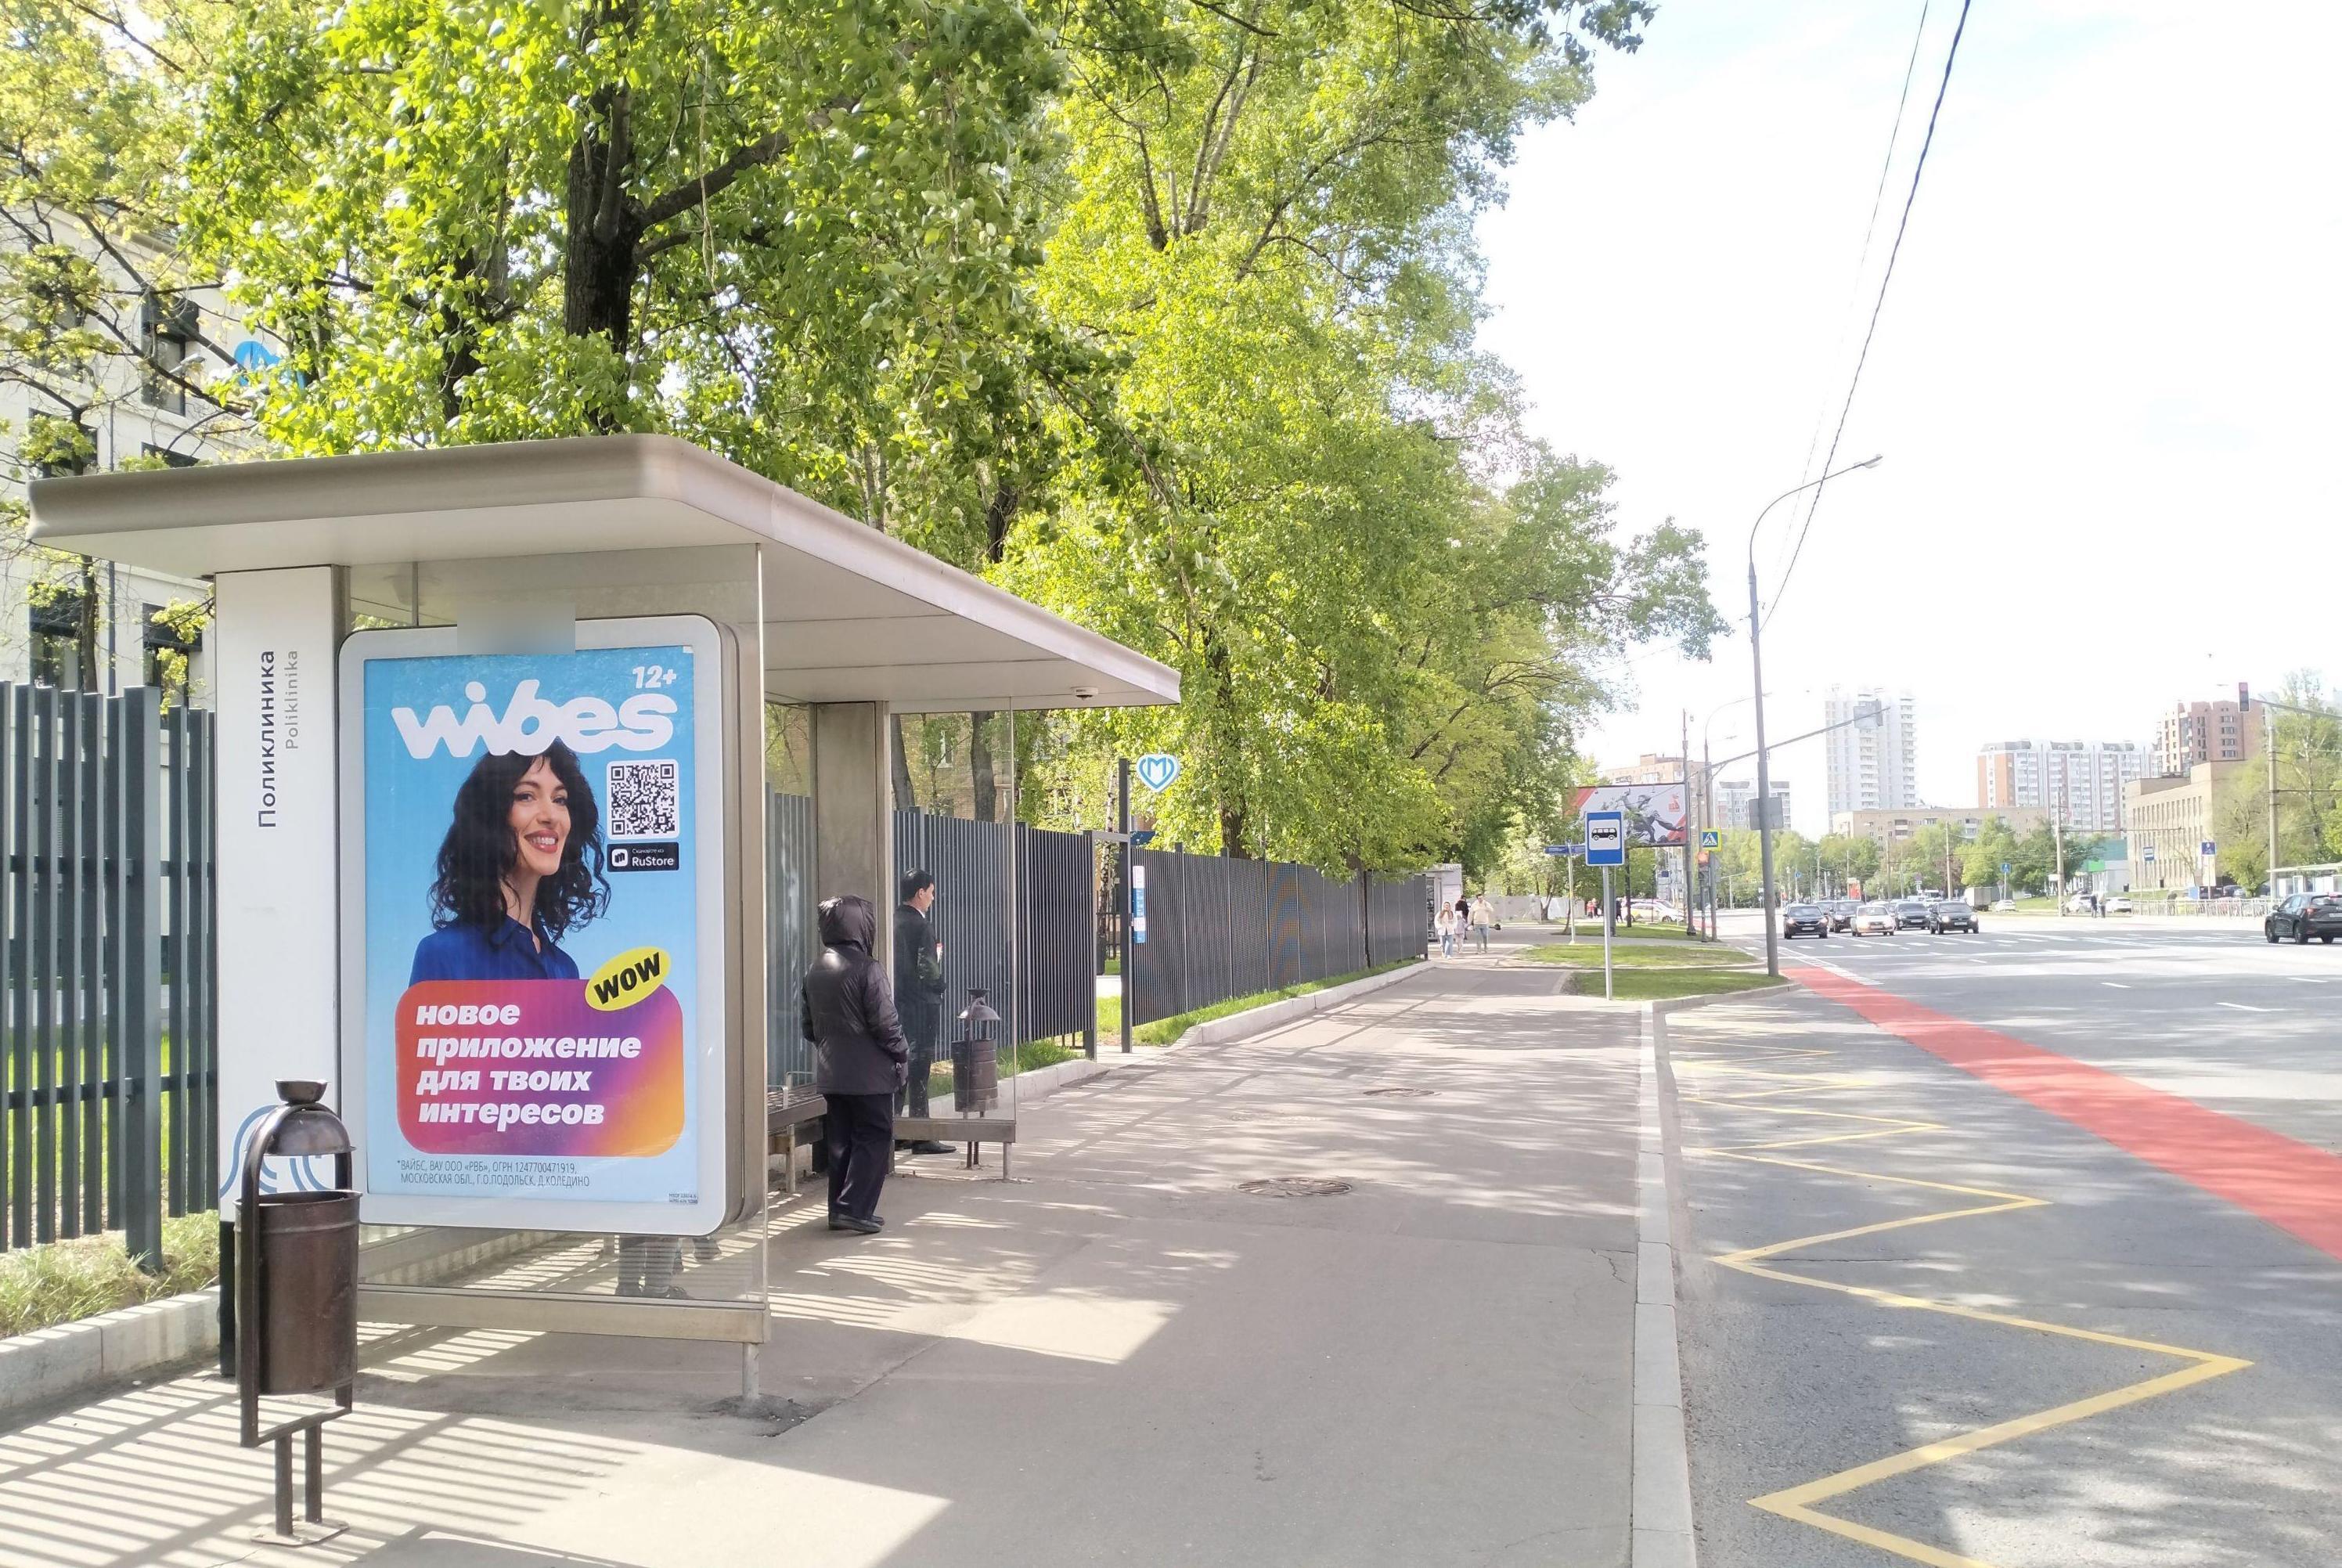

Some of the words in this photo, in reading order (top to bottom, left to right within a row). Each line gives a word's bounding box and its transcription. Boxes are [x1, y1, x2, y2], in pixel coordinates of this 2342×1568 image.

[632, 665, 677, 689] 12+
[284, 651, 299, 749] Poliklinika
[391, 679, 678, 759] wibes
[258, 651, 276, 827] Поликлиника
[632, 856, 674, 867] RuStore
[416, 1004, 521, 1026] новое
[416, 1036, 642, 1066] приложение
[416, 1070, 481, 1096] для
[489, 1070, 593, 1092] твоих
[418, 1102, 605, 1132] интересов
[401, 1173, 452, 1184] МОСКОВСКАЯ
[430, 1162, 442, 1172] ВАУ
[445, 1162, 463, 1172] ООО
[492, 1162, 513, 1173] ОГРН
